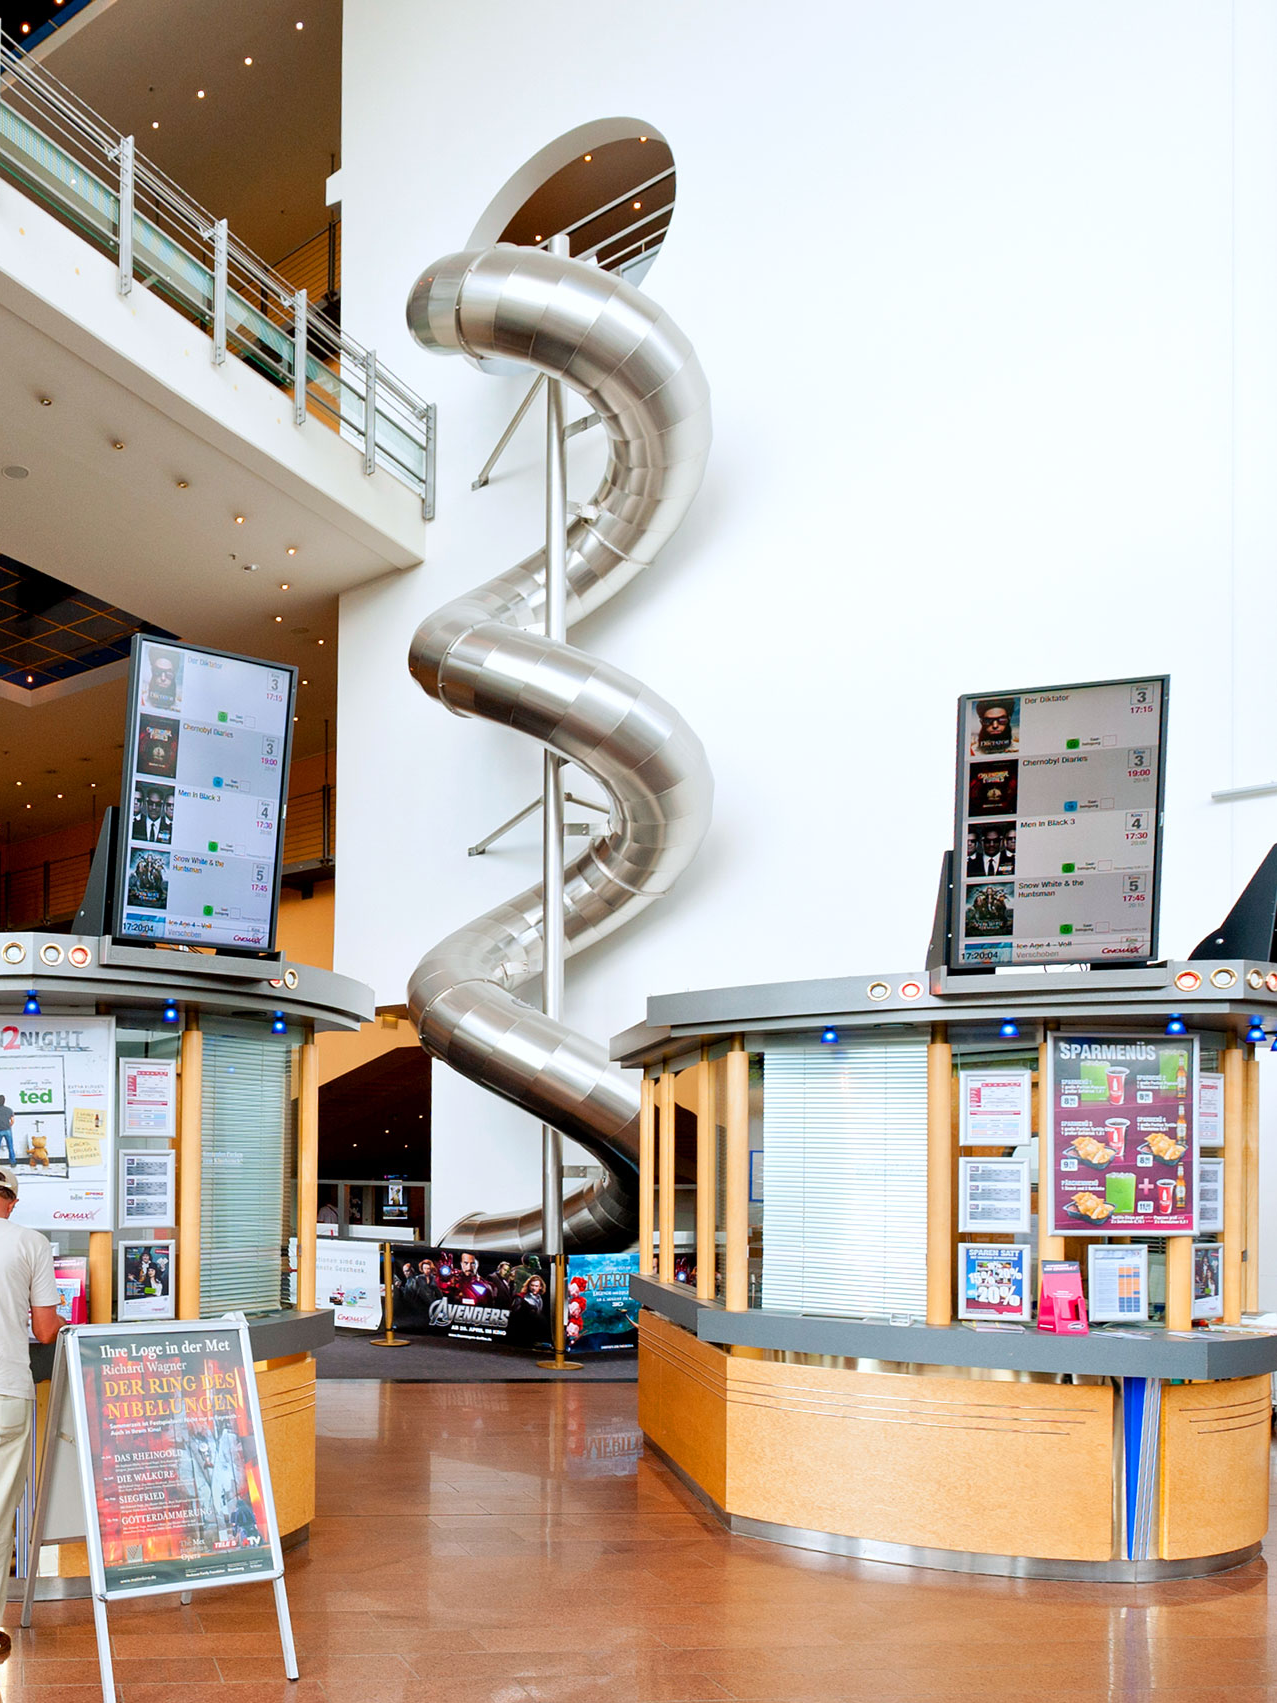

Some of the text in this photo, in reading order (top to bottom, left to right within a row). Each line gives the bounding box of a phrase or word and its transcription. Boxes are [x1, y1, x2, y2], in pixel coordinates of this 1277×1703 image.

[272, 679, 279, 691] 3
[266, 692, 282, 702] 17:15
[1040, 694, 1070, 703] Diktator
[1137, 692, 1146, 703] 3
[1130, 705, 1153, 714] 17:15
[183, 722, 212, 734] Chernobyl
[213, 728, 234, 738] Diaries
[266, 743, 274, 755] 3
[261, 757, 278, 766] 19:00
[1022, 755, 1088, 766] Chernobyl Diaries
[1134, 755, 1144, 766] 3
[1128, 769, 1150, 777] 19:00
[178, 789, 192, 798] Men
[199, 792, 216, 801] Black
[261, 807, 268, 819] 4
[256, 820, 272, 830] 17:30
[1047, 818, 1069, 826] Black
[1132, 818, 1141, 829] 4
[1125, 832, 1148, 840] 17:30
[173, 854, 190, 864] Snow
[192, 856, 208, 866] White
[172, 864, 202, 874] Huntsman
[256, 870, 264, 882] 5
[251, 884, 268, 892] 17:45
[1018, 881, 1040, 889] Snow
[1129, 880, 1138, 892] 5
[1018, 890, 1056, 898] Huntsman
[123, 922, 154, 932] 17:20:04
[168, 928, 202, 938] Verschoben
[961, 952, 998, 960] 17:20:04
[1016, 950, 1059, 958] Verschoben
[1060, 1042, 1156, 1060] SPARMENÜS
[19, 1089, 52, 1104] ted
[968, 1271, 995, 1284] 15%
[998, 1267, 1022, 1280] 20%
[585, 1273, 629, 1291] MERI
[978, 1286, 1020, 1306] 20%
[429, 1297, 510, 1328] AVENGERS
[100, 1340, 230, 1359] Ihre Loge in der Met
[102, 1361, 187, 1376] Richard Wagner
[104, 1372, 235, 1397] DER RING DES
[106, 1394, 239, 1420] NIBELUNGEN
[114, 1449, 183, 1462] DAS RHEINGOLD
[117, 1470, 176, 1484] DIE WALKÜRE
[119, 1492, 165, 1504] SIEGFRIED
[122, 1508, 212, 1525] GÖTTERDÄMMERUNG
[242, 1536, 261, 1546] ATV
[181, 1553, 201, 1562] Opera
